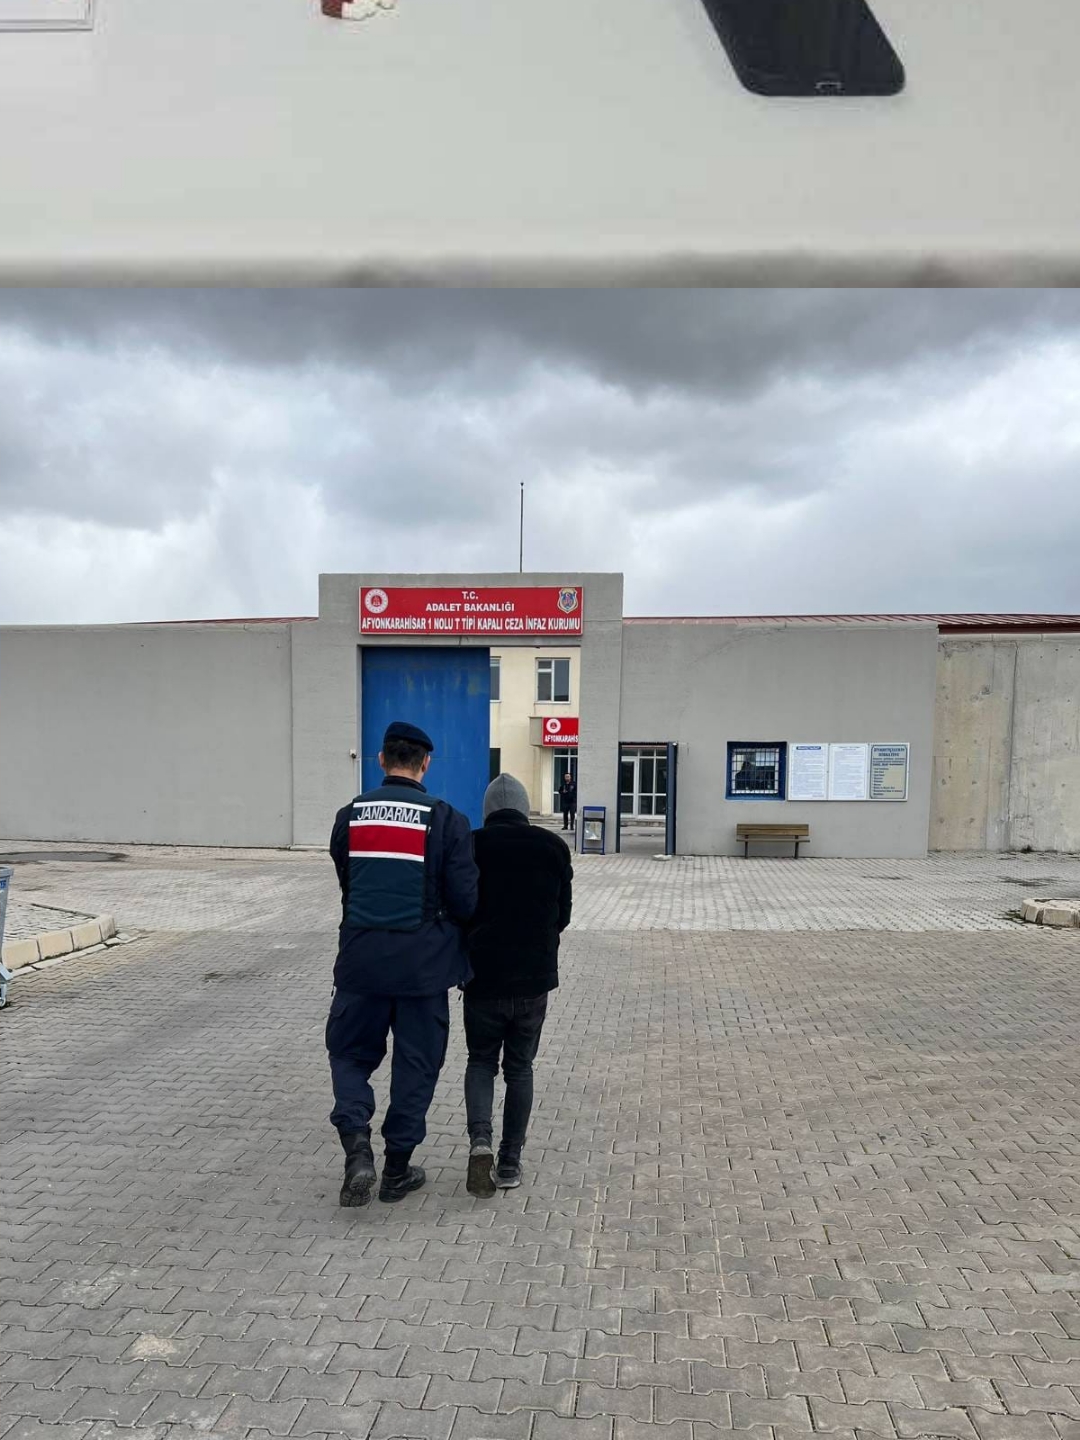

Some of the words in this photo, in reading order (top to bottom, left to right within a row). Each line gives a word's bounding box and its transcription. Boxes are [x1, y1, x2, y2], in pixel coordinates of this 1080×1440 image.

[462, 591, 478, 600] T.C.
[426, 603, 461, 612] ADALET
[464, 601, 515, 612] BAKANLIĞI
[362, 615, 426, 630] AFYONKARAHİSAR
[428, 618, 432, 630] 1
[434, 617, 454, 630] NOLU
[455, 618, 460, 630] T
[461, 615, 476, 630] TİPİ
[477, 617, 503, 630] KAPALI
[504, 617, 524, 630] CEZA
[525, 615, 547, 630] İNFAZ
[548, 617, 581, 630] KURUMU
[357, 805, 421, 823] JANDARMA
